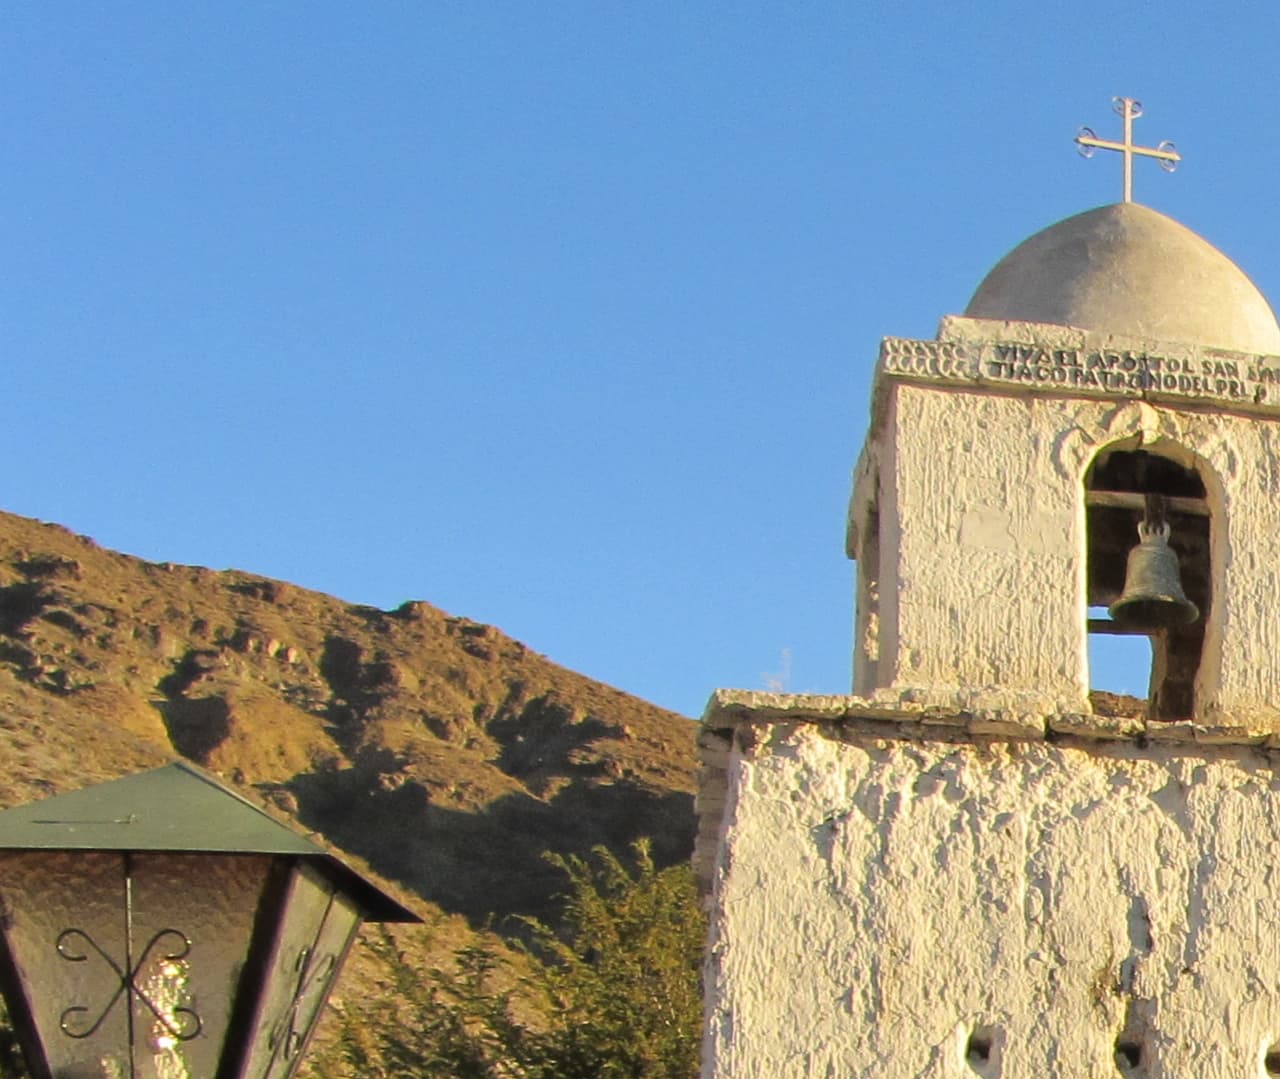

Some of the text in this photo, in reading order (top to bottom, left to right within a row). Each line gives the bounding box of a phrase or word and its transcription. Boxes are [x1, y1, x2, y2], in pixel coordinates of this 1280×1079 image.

[991, 344, 1050, 364] VIVA
[1054, 349, 1084, 366] EL
[1200, 358, 1239, 379] SAN
[1178, 373, 1217, 393] DEL
